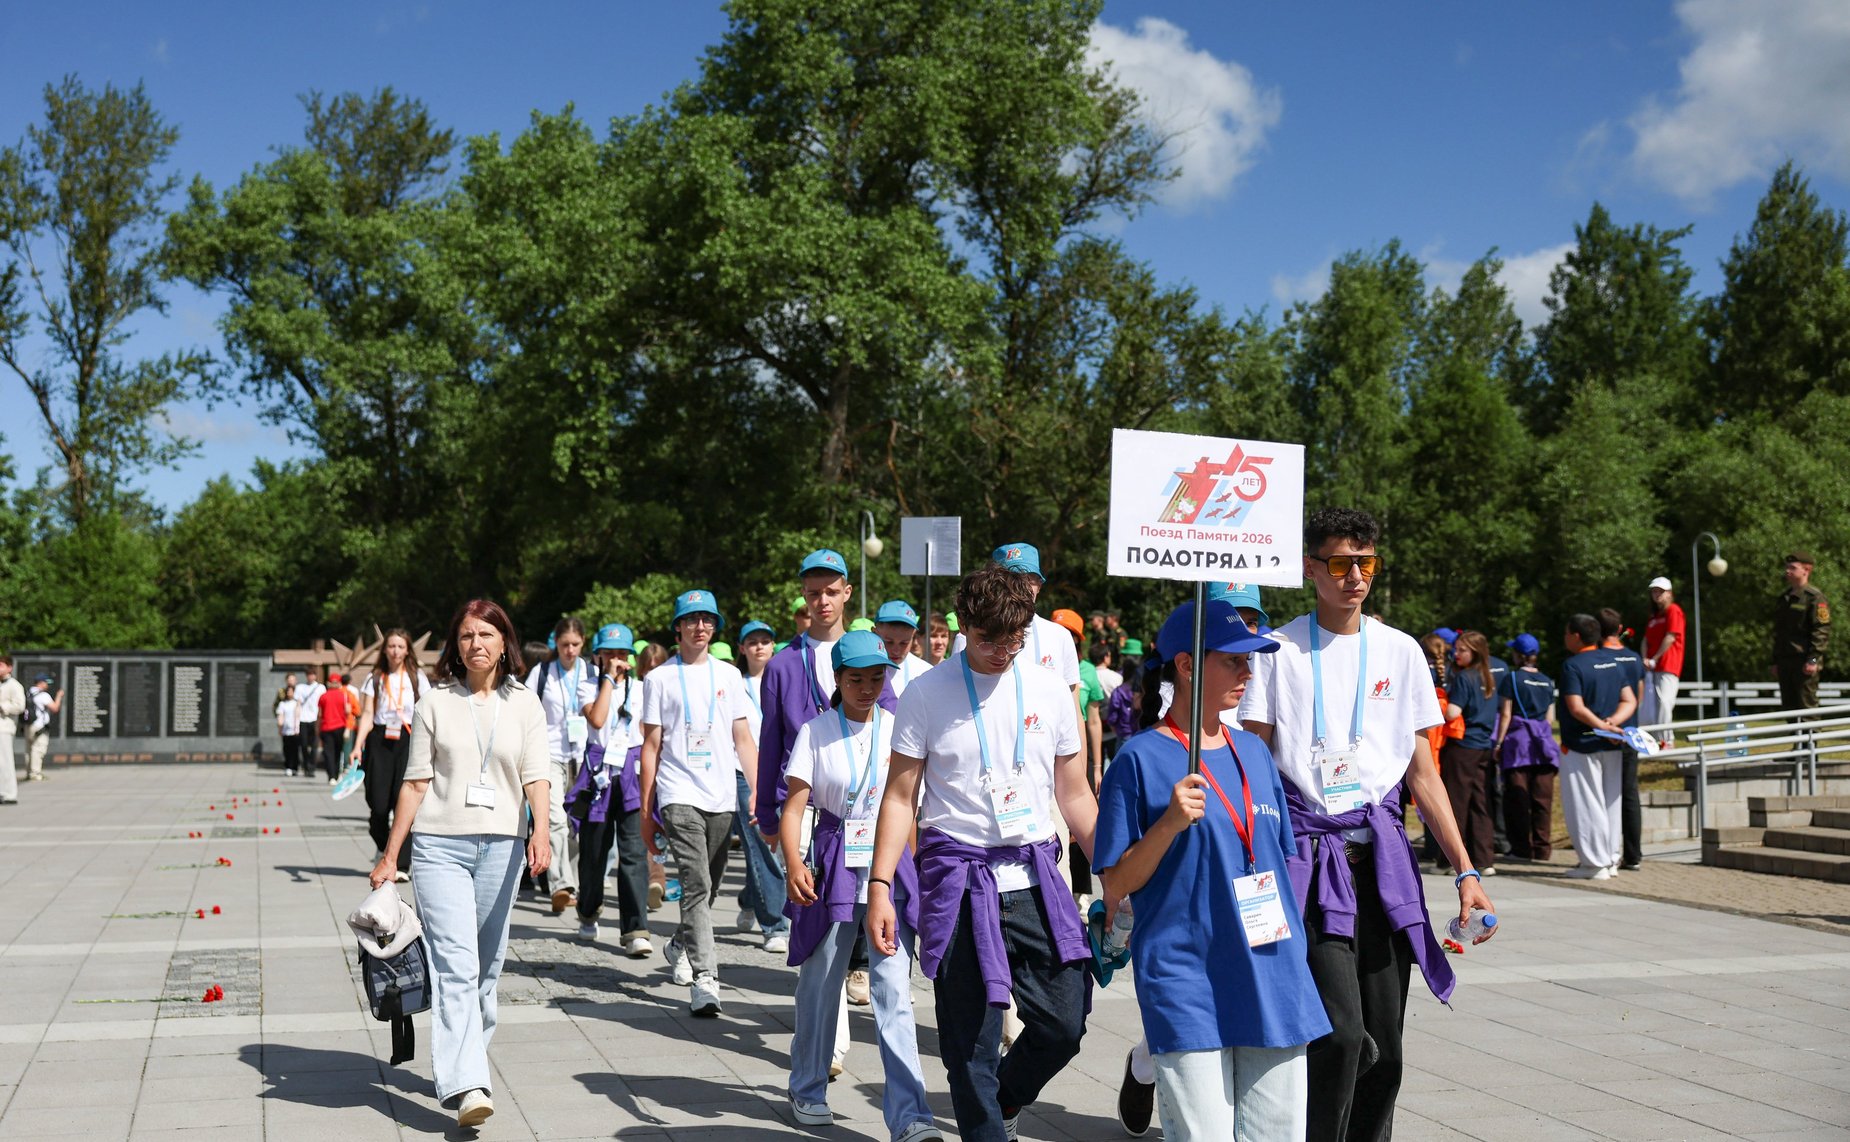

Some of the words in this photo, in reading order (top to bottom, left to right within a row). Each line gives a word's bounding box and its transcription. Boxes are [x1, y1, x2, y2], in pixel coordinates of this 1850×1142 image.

[1242, 478, 1260, 486] ЛЕТ
[1141, 526, 1182, 539] Поезд
[1187, 529, 1238, 542] Памяти
[1241, 532, 1273, 545] 2026
[1127, 547, 1248, 569] ПОДОТРЯД
